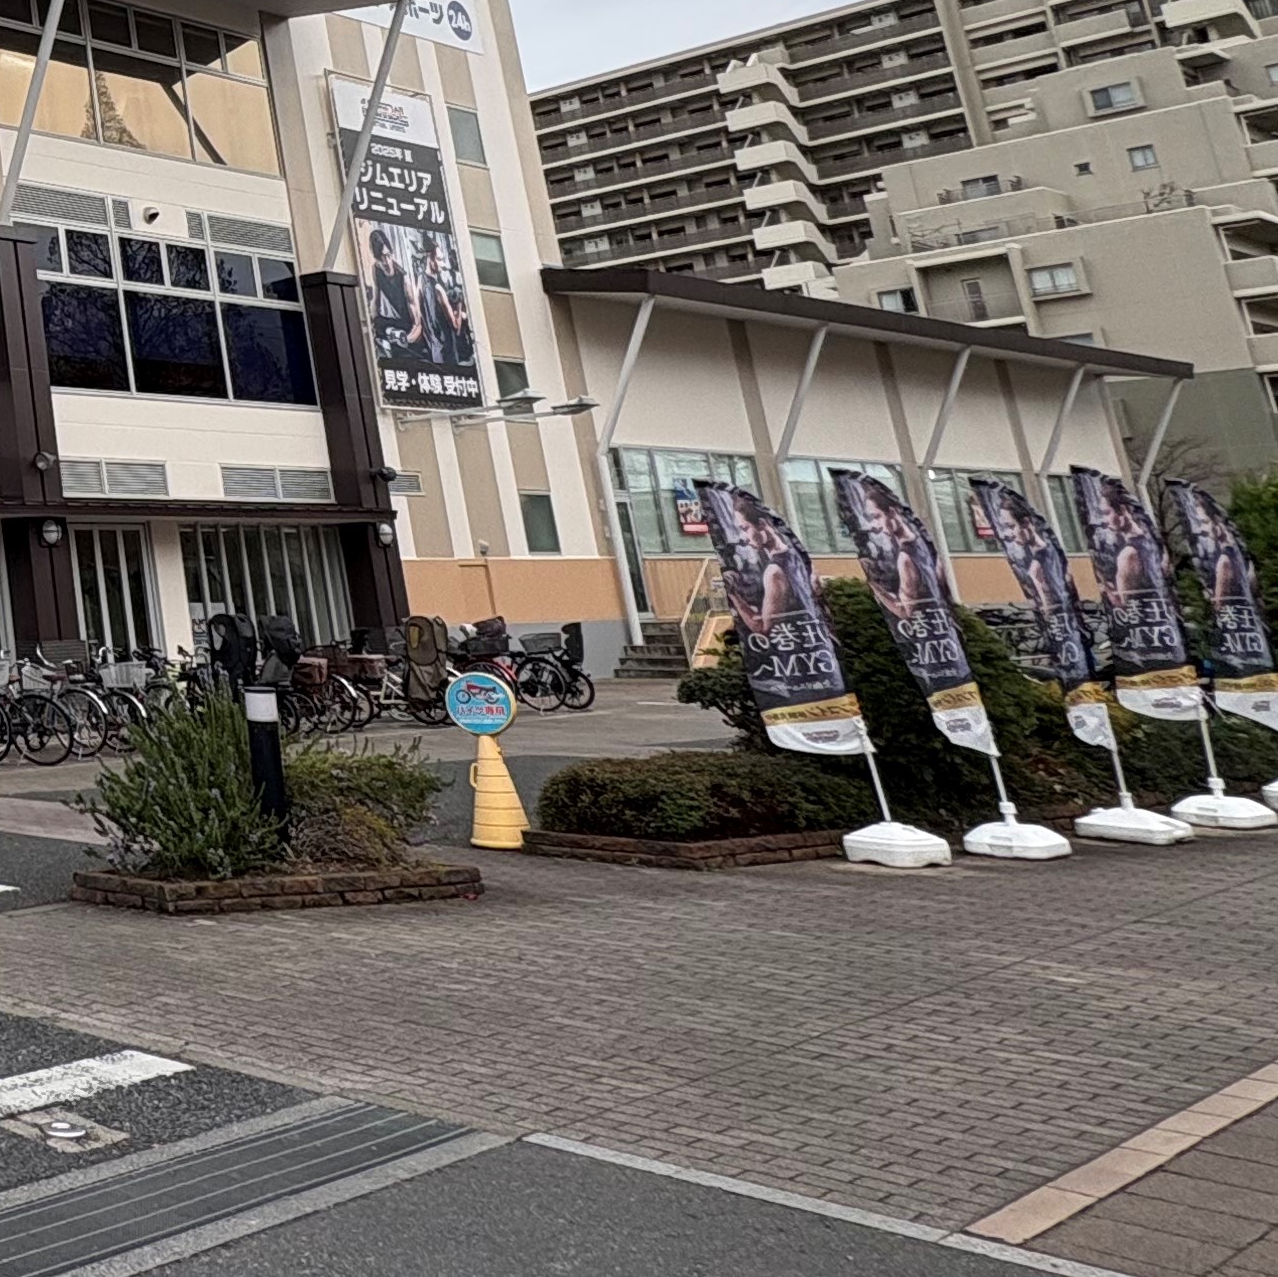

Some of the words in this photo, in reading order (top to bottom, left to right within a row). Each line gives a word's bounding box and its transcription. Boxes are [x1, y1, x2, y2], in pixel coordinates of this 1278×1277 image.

[448, 9, 472, 33] 24h
[359, 159, 433, 195] ジムエリア
[354, 185, 446, 225] リニューアル
